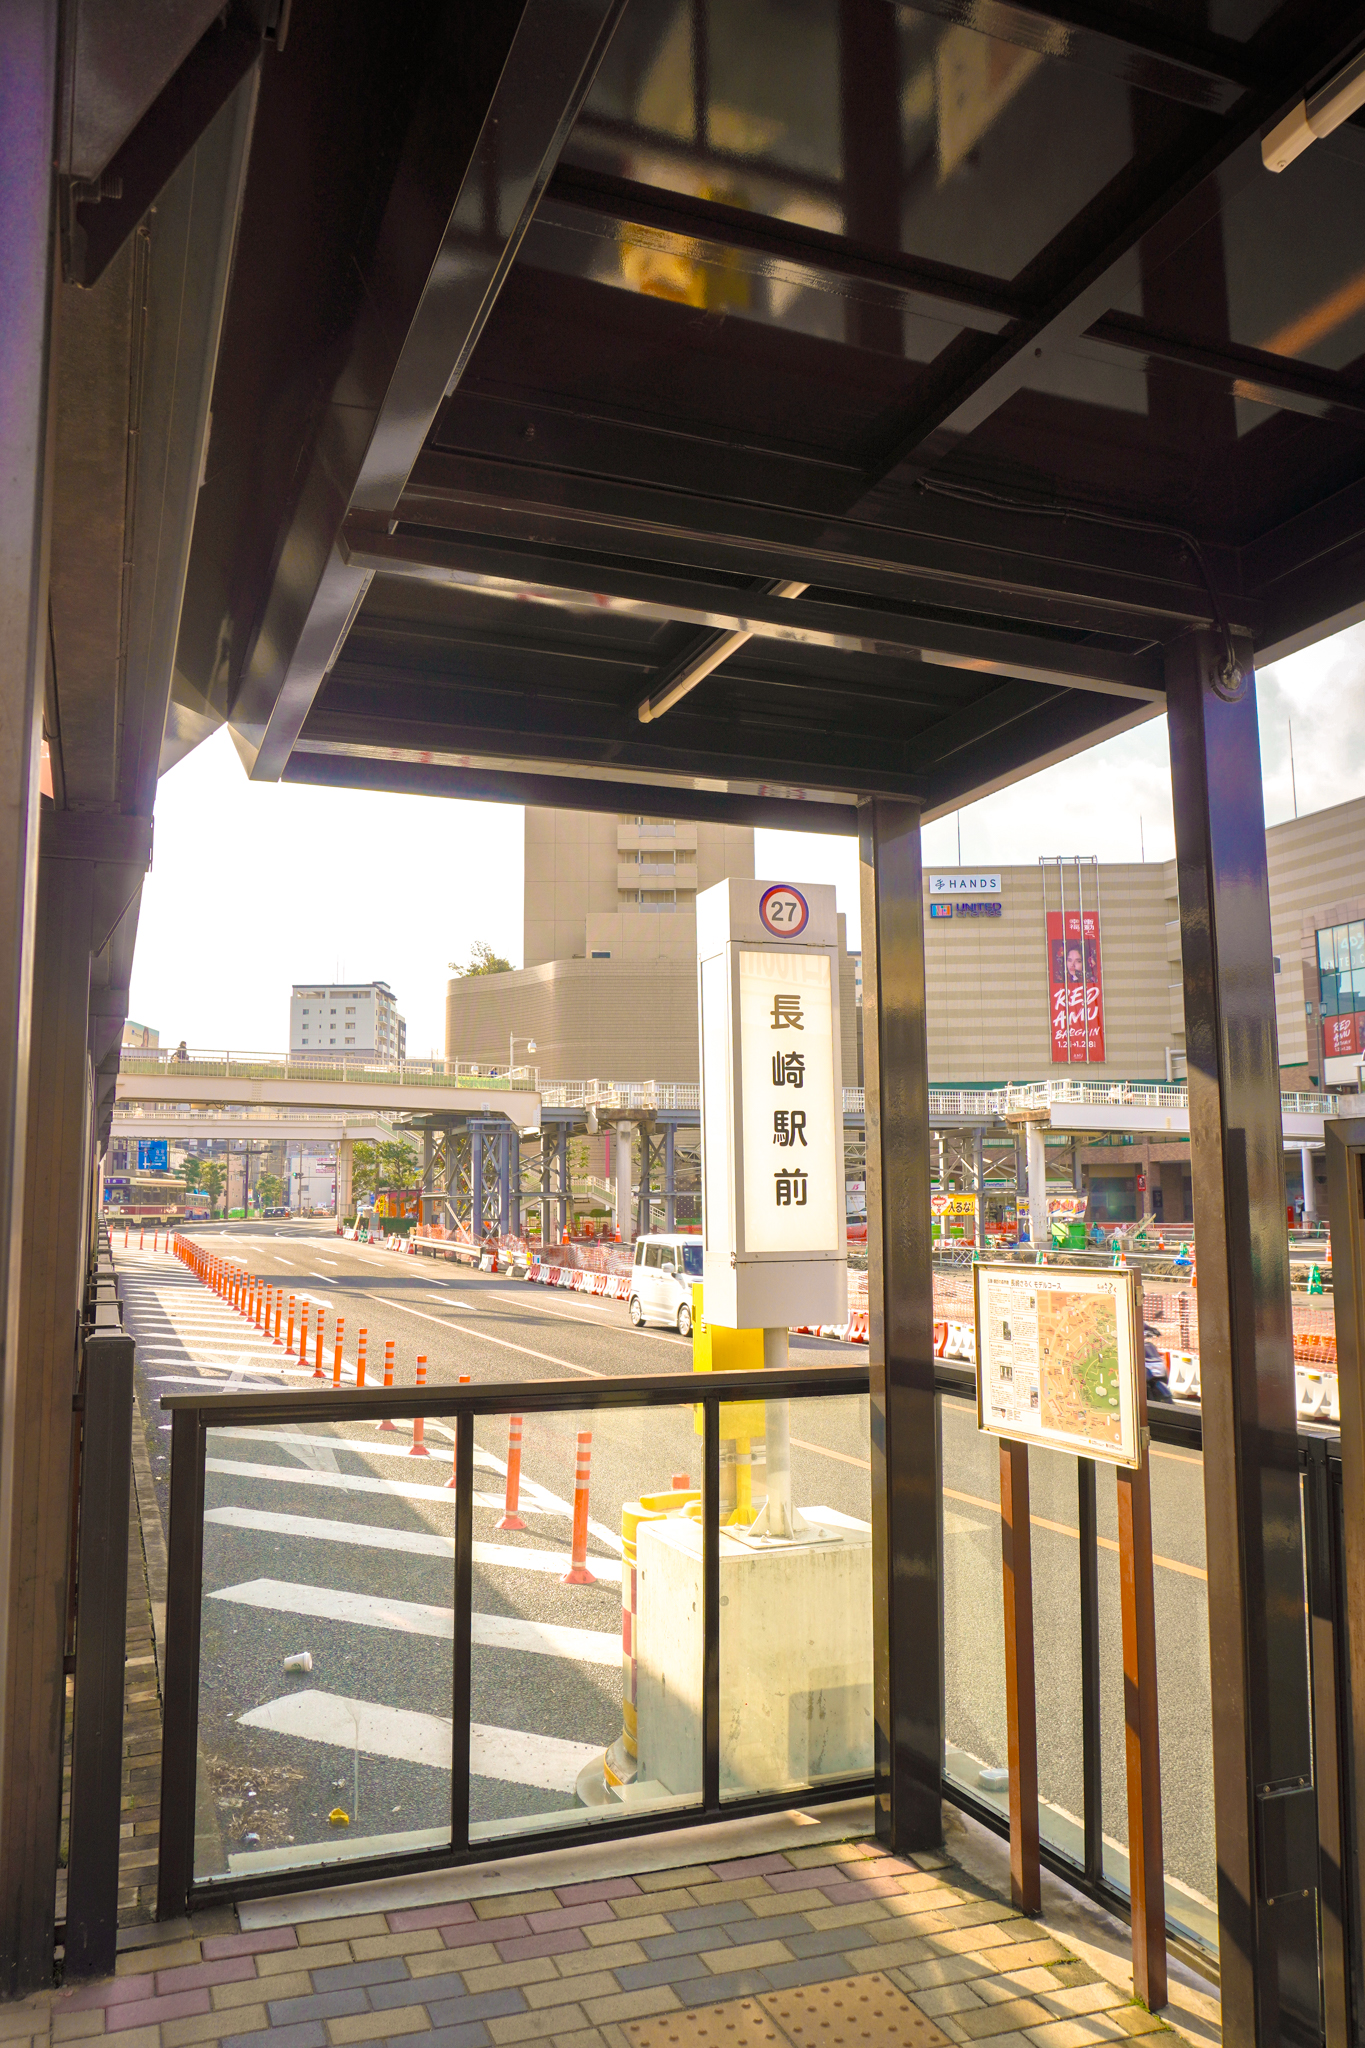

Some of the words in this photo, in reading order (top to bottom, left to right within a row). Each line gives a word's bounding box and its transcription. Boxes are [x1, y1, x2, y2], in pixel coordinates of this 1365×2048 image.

[949, 878, 997, 889] HANDS
[770, 900, 797, 922] 27
[956, 902, 1002, 912] UNITED
[1053, 985, 1100, 1011] RED
[1052, 1006, 1099, 1030] AMU
[770, 993, 809, 1207] 長崎駅前
[1034, 1280, 1062, 1290] モデルコース
